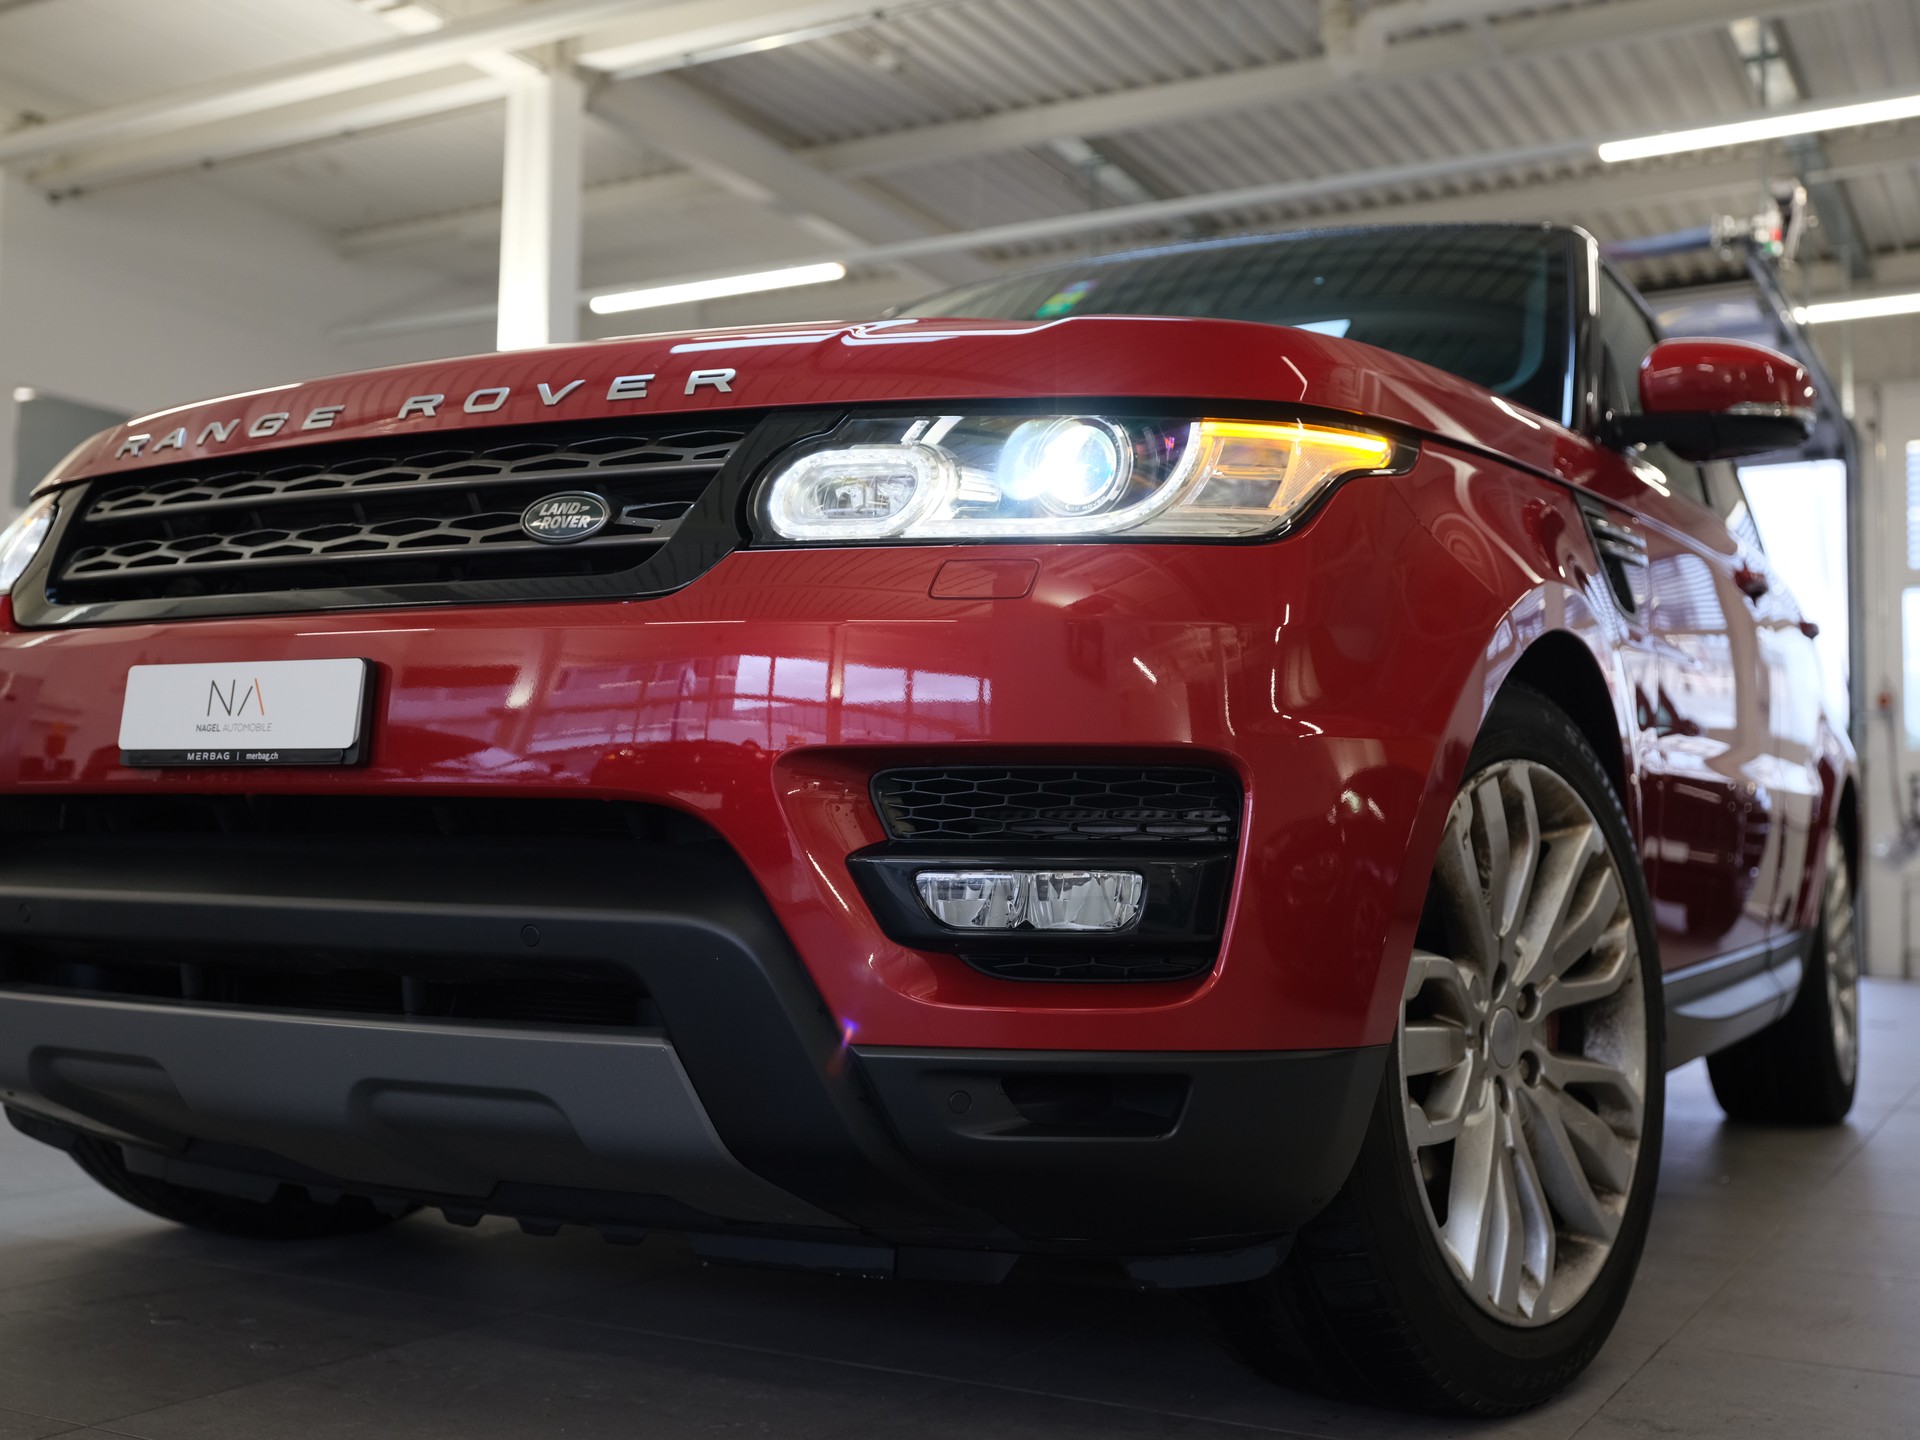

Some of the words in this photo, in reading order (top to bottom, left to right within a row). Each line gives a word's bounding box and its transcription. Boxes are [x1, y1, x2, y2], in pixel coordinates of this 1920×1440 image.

[114, 404, 345, 460] RANGE
[397, 367, 737, 421] ROVER
[539, 502, 581, 516] LAND
[539, 514, 591, 530] ROVER
[195, 723, 221, 733] NAGEL
[222, 722, 273, 733] AUTOMOBILE
[186, 751, 231, 761] MERBAG
[245, 751, 279, 762] merbag.ch
